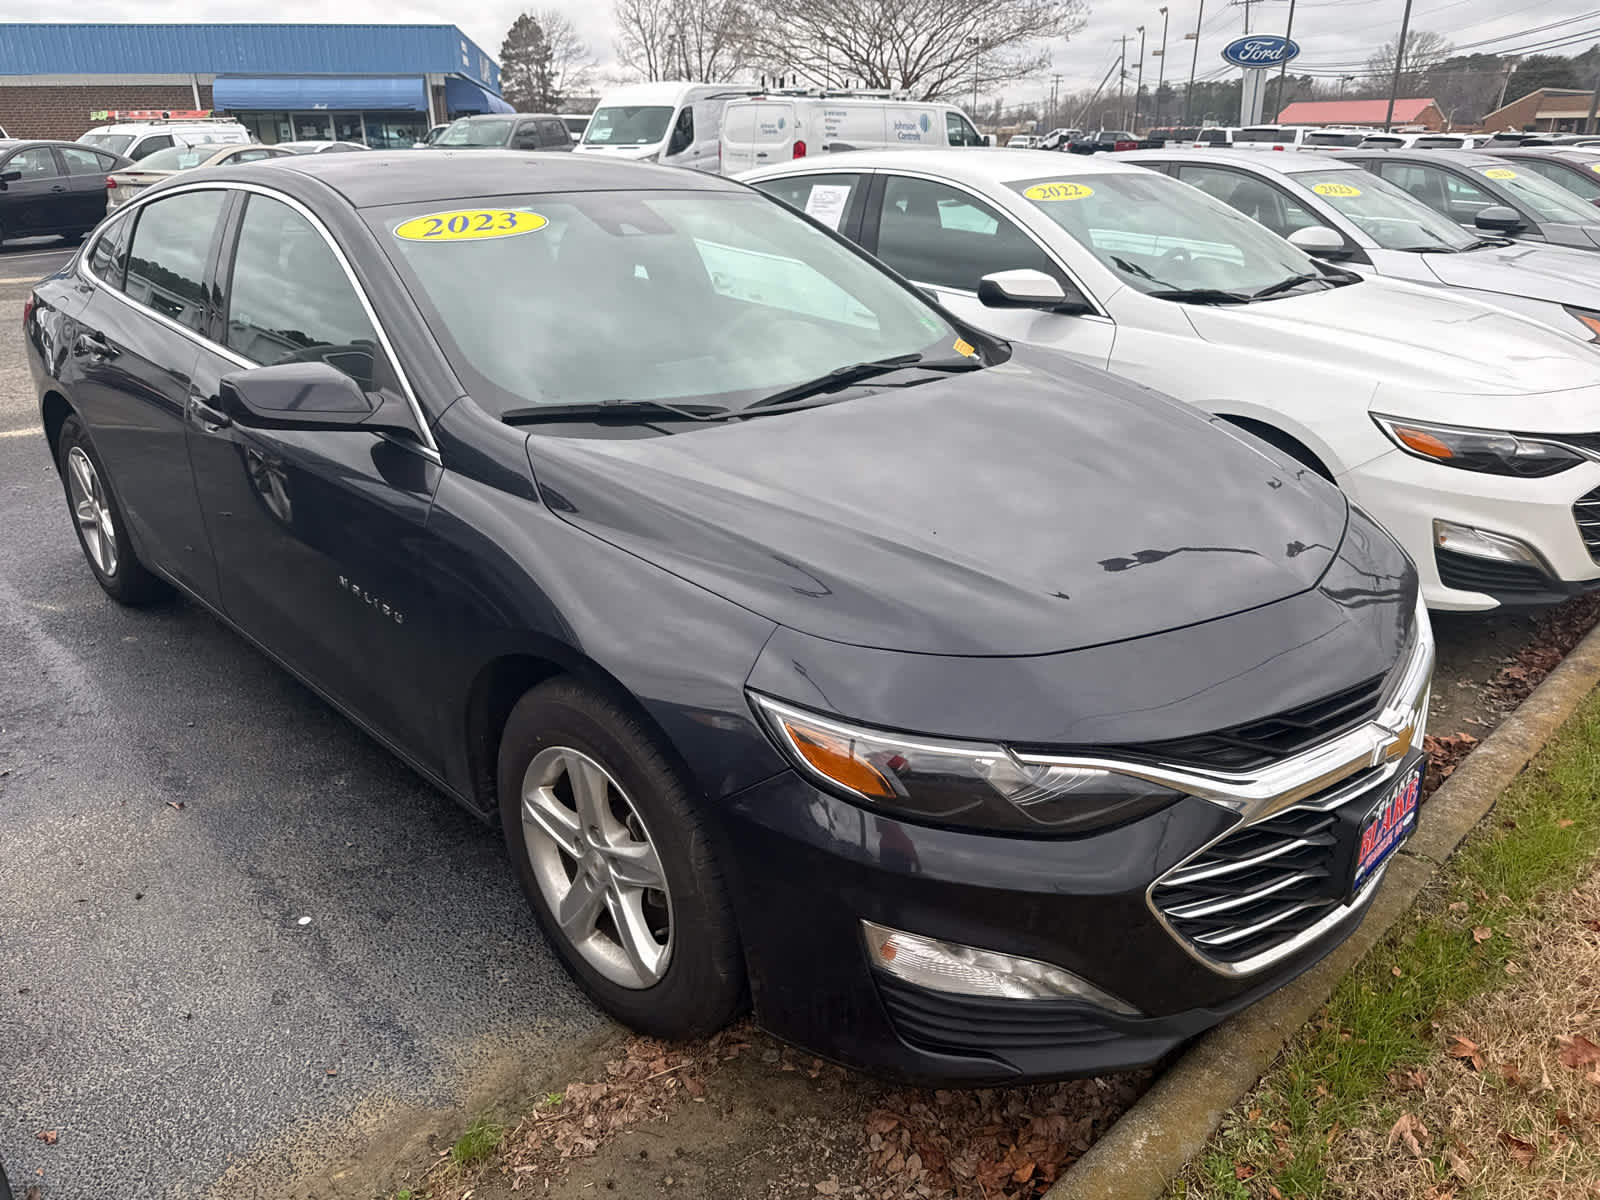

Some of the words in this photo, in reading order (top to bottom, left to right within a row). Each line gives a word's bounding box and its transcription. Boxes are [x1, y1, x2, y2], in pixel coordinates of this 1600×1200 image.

[1240, 40, 1286, 60] Ford
[1036, 184, 1083, 199] 2022
[422, 212, 518, 238] 2023
[338, 575, 404, 624] MALIBU
